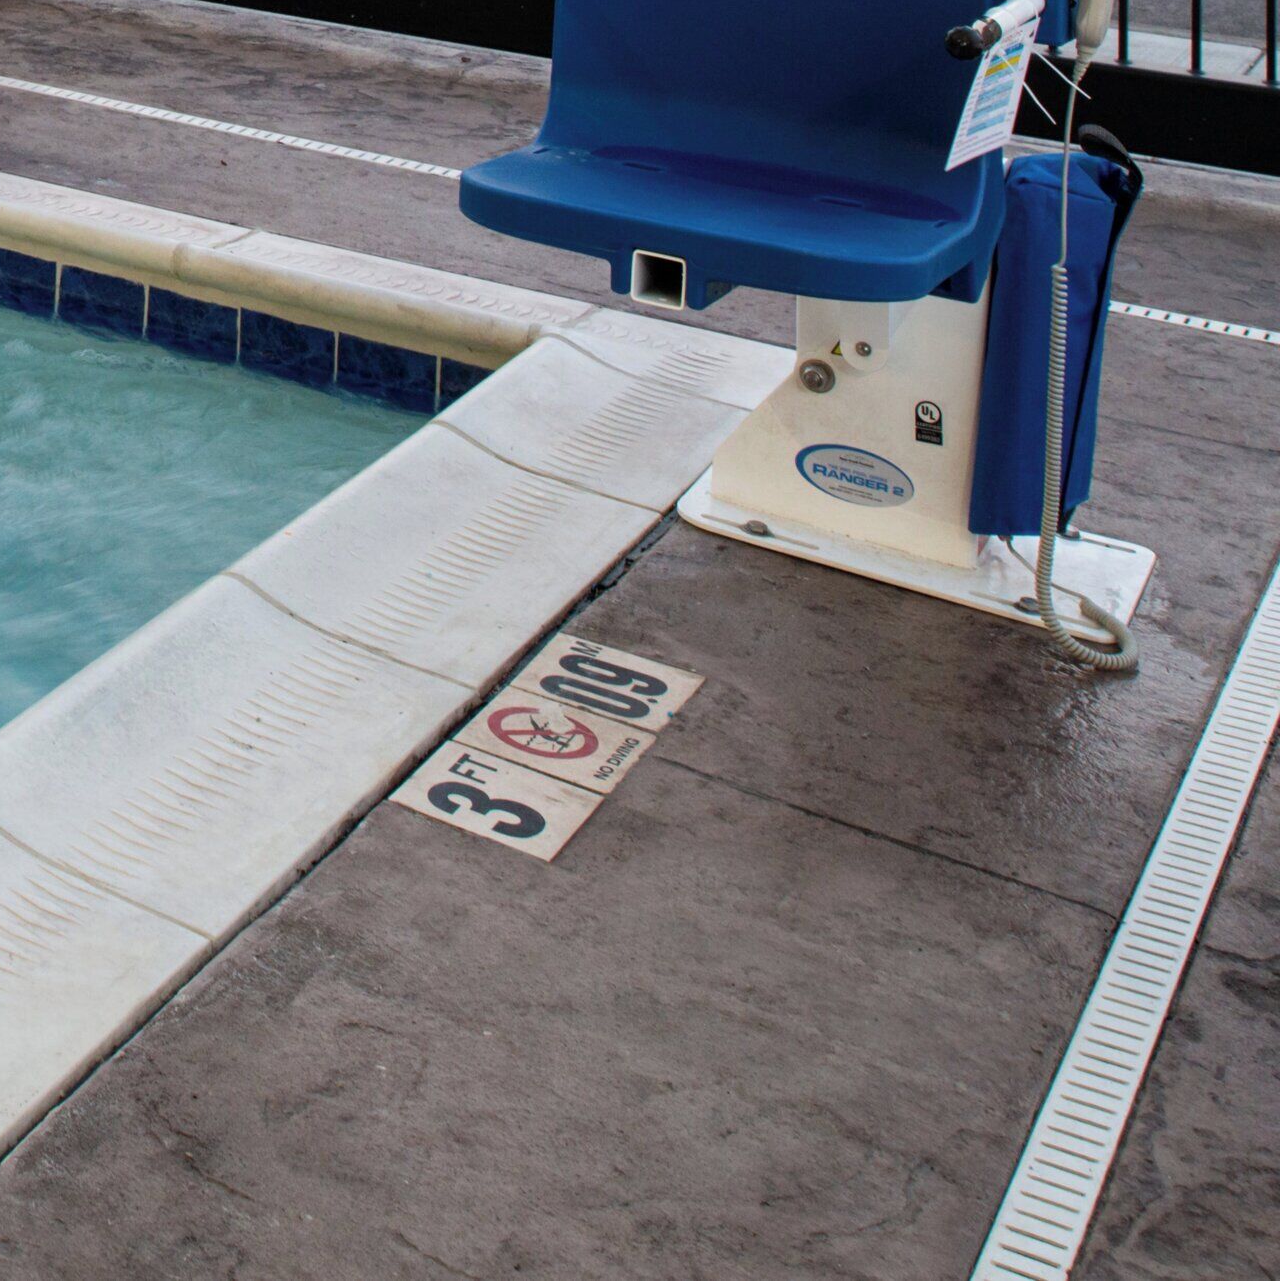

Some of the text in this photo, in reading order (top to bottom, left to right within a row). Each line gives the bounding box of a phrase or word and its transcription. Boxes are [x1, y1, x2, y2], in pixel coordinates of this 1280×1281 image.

[812, 463, 888, 493] RANGER
[893, 486, 905, 497] 2
[593, 737, 640, 781] NO DIVING
[427, 753, 546, 838] 3 FT
